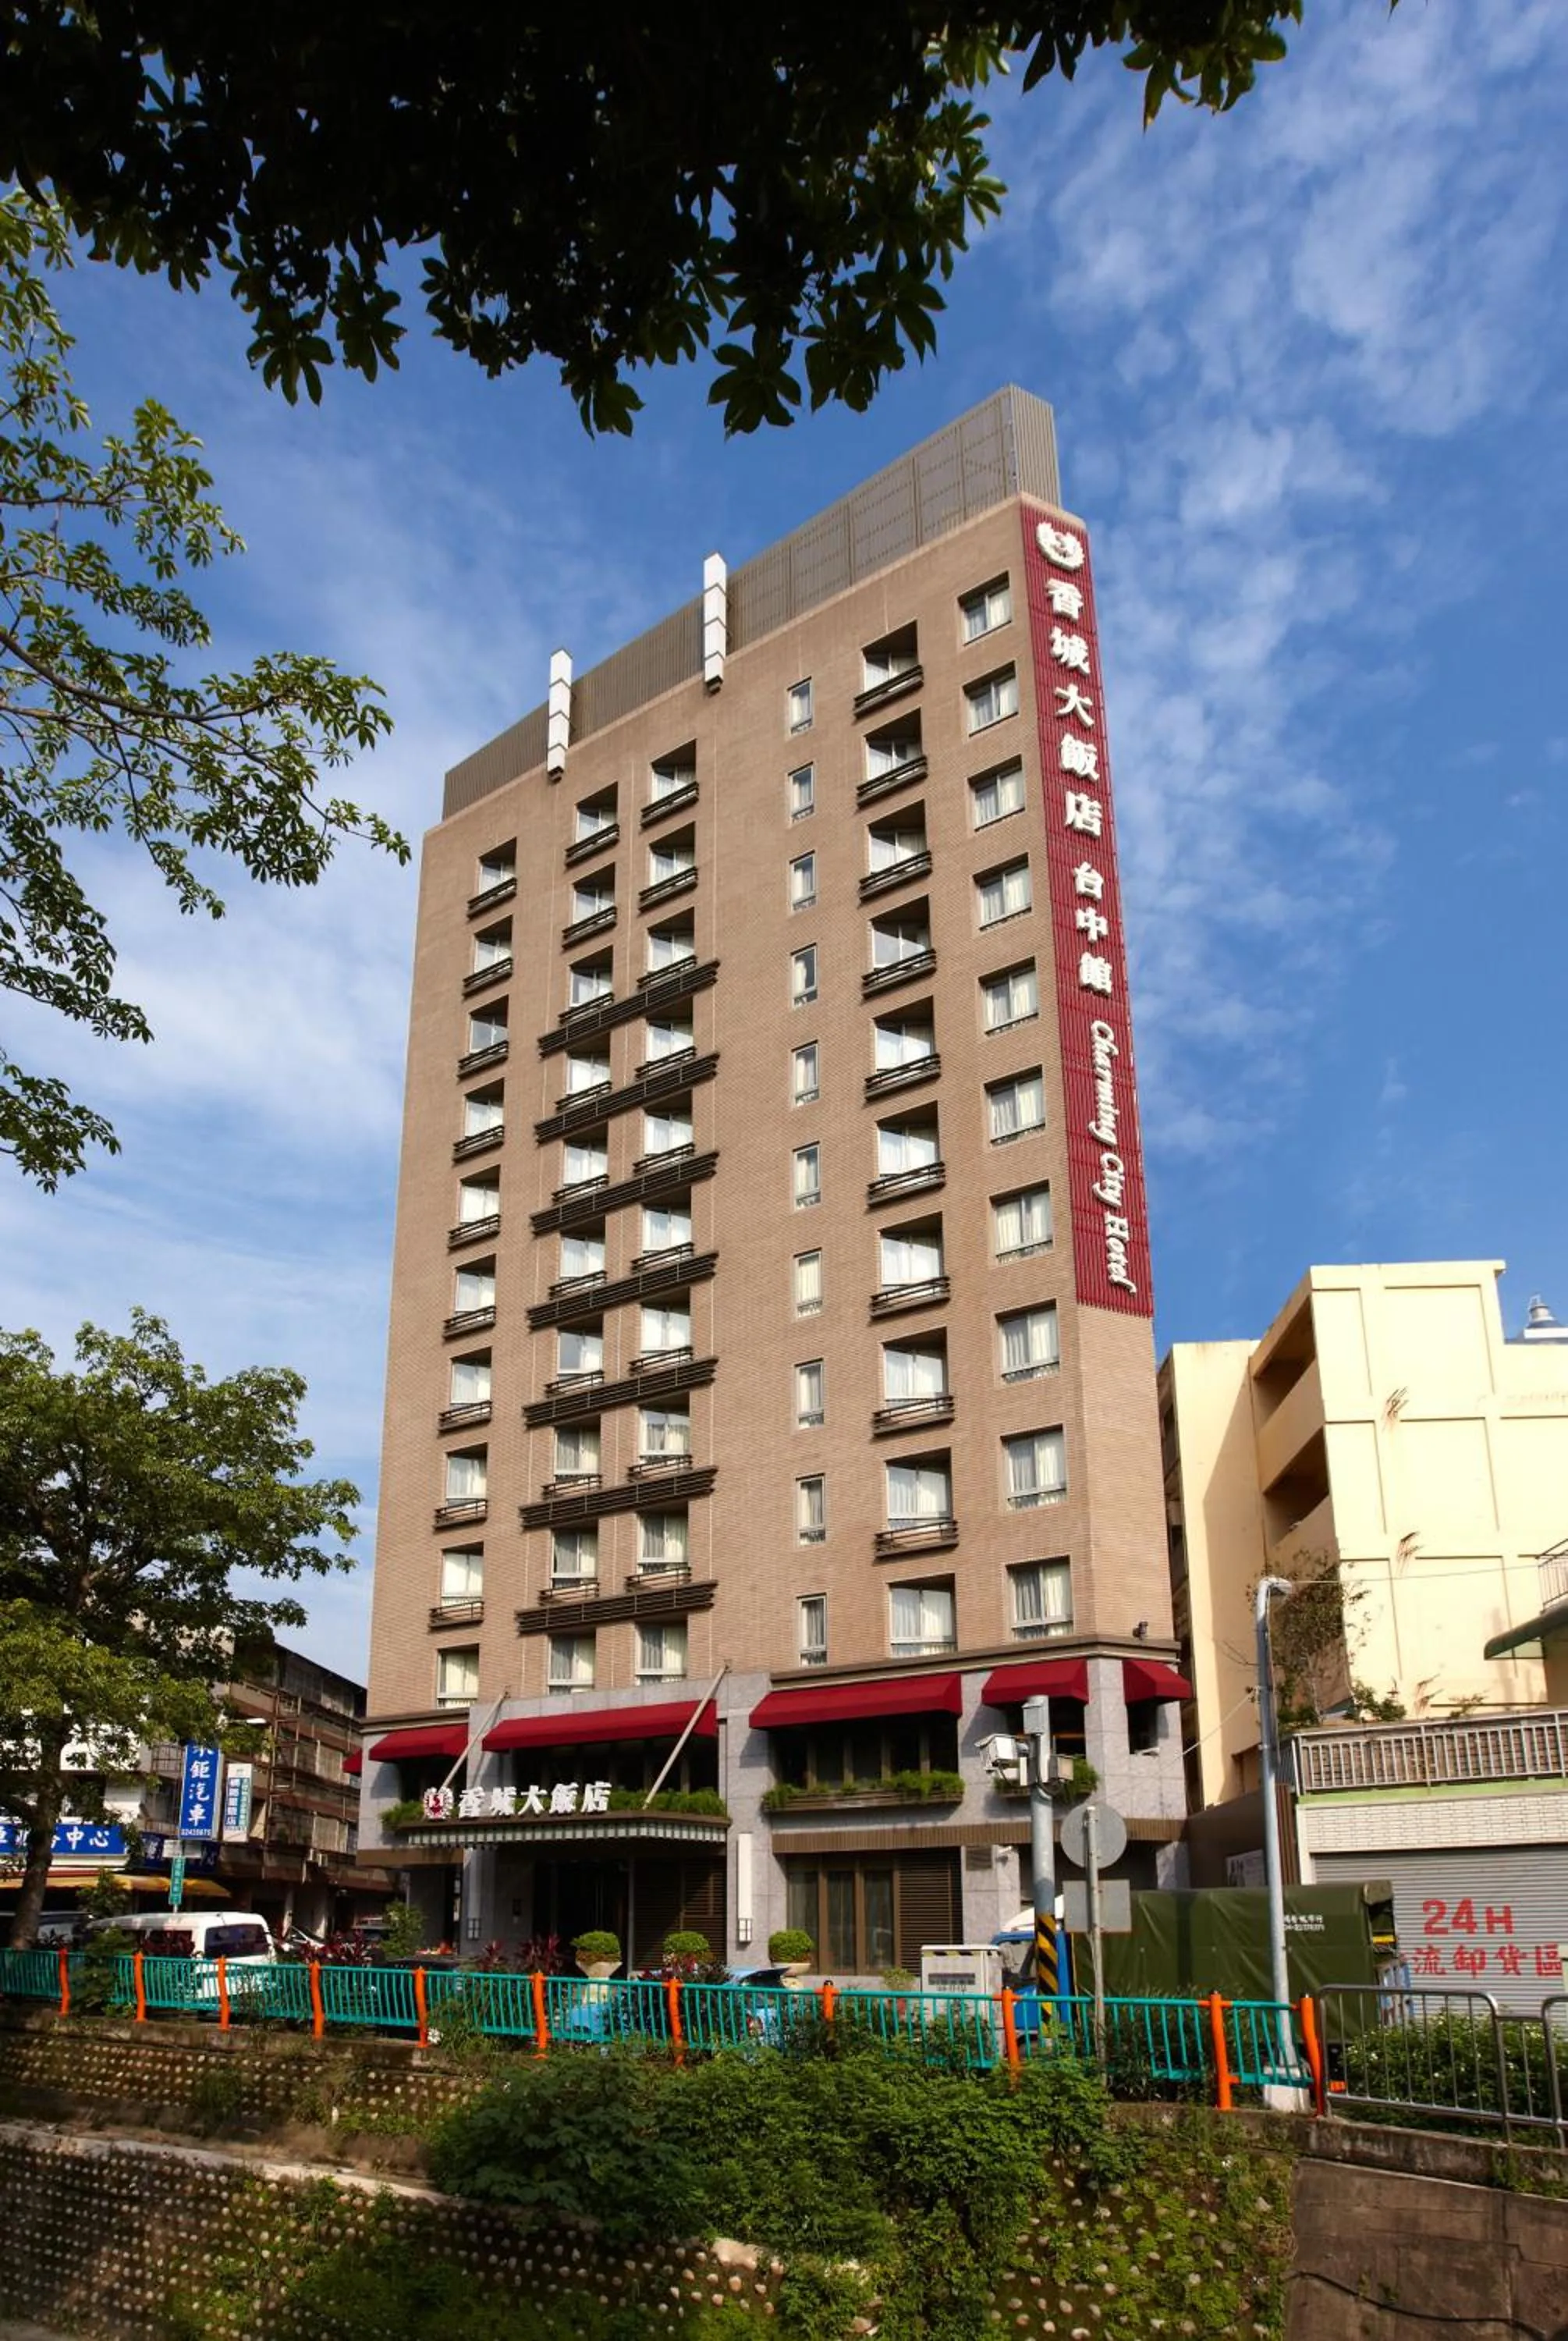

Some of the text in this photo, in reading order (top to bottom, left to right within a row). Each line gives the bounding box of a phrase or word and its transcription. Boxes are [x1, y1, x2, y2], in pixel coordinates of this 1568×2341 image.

[1046, 577, 1113, 996] 香城大飯店 台中館
[1089, 1020, 1137, 1295] Charming City Hotel
[458, 1781, 612, 1818] 香城大飯店
[1422, 1898, 1513, 1934] 24H
[1399, 1941, 1563, 1979] 流卸貨區
